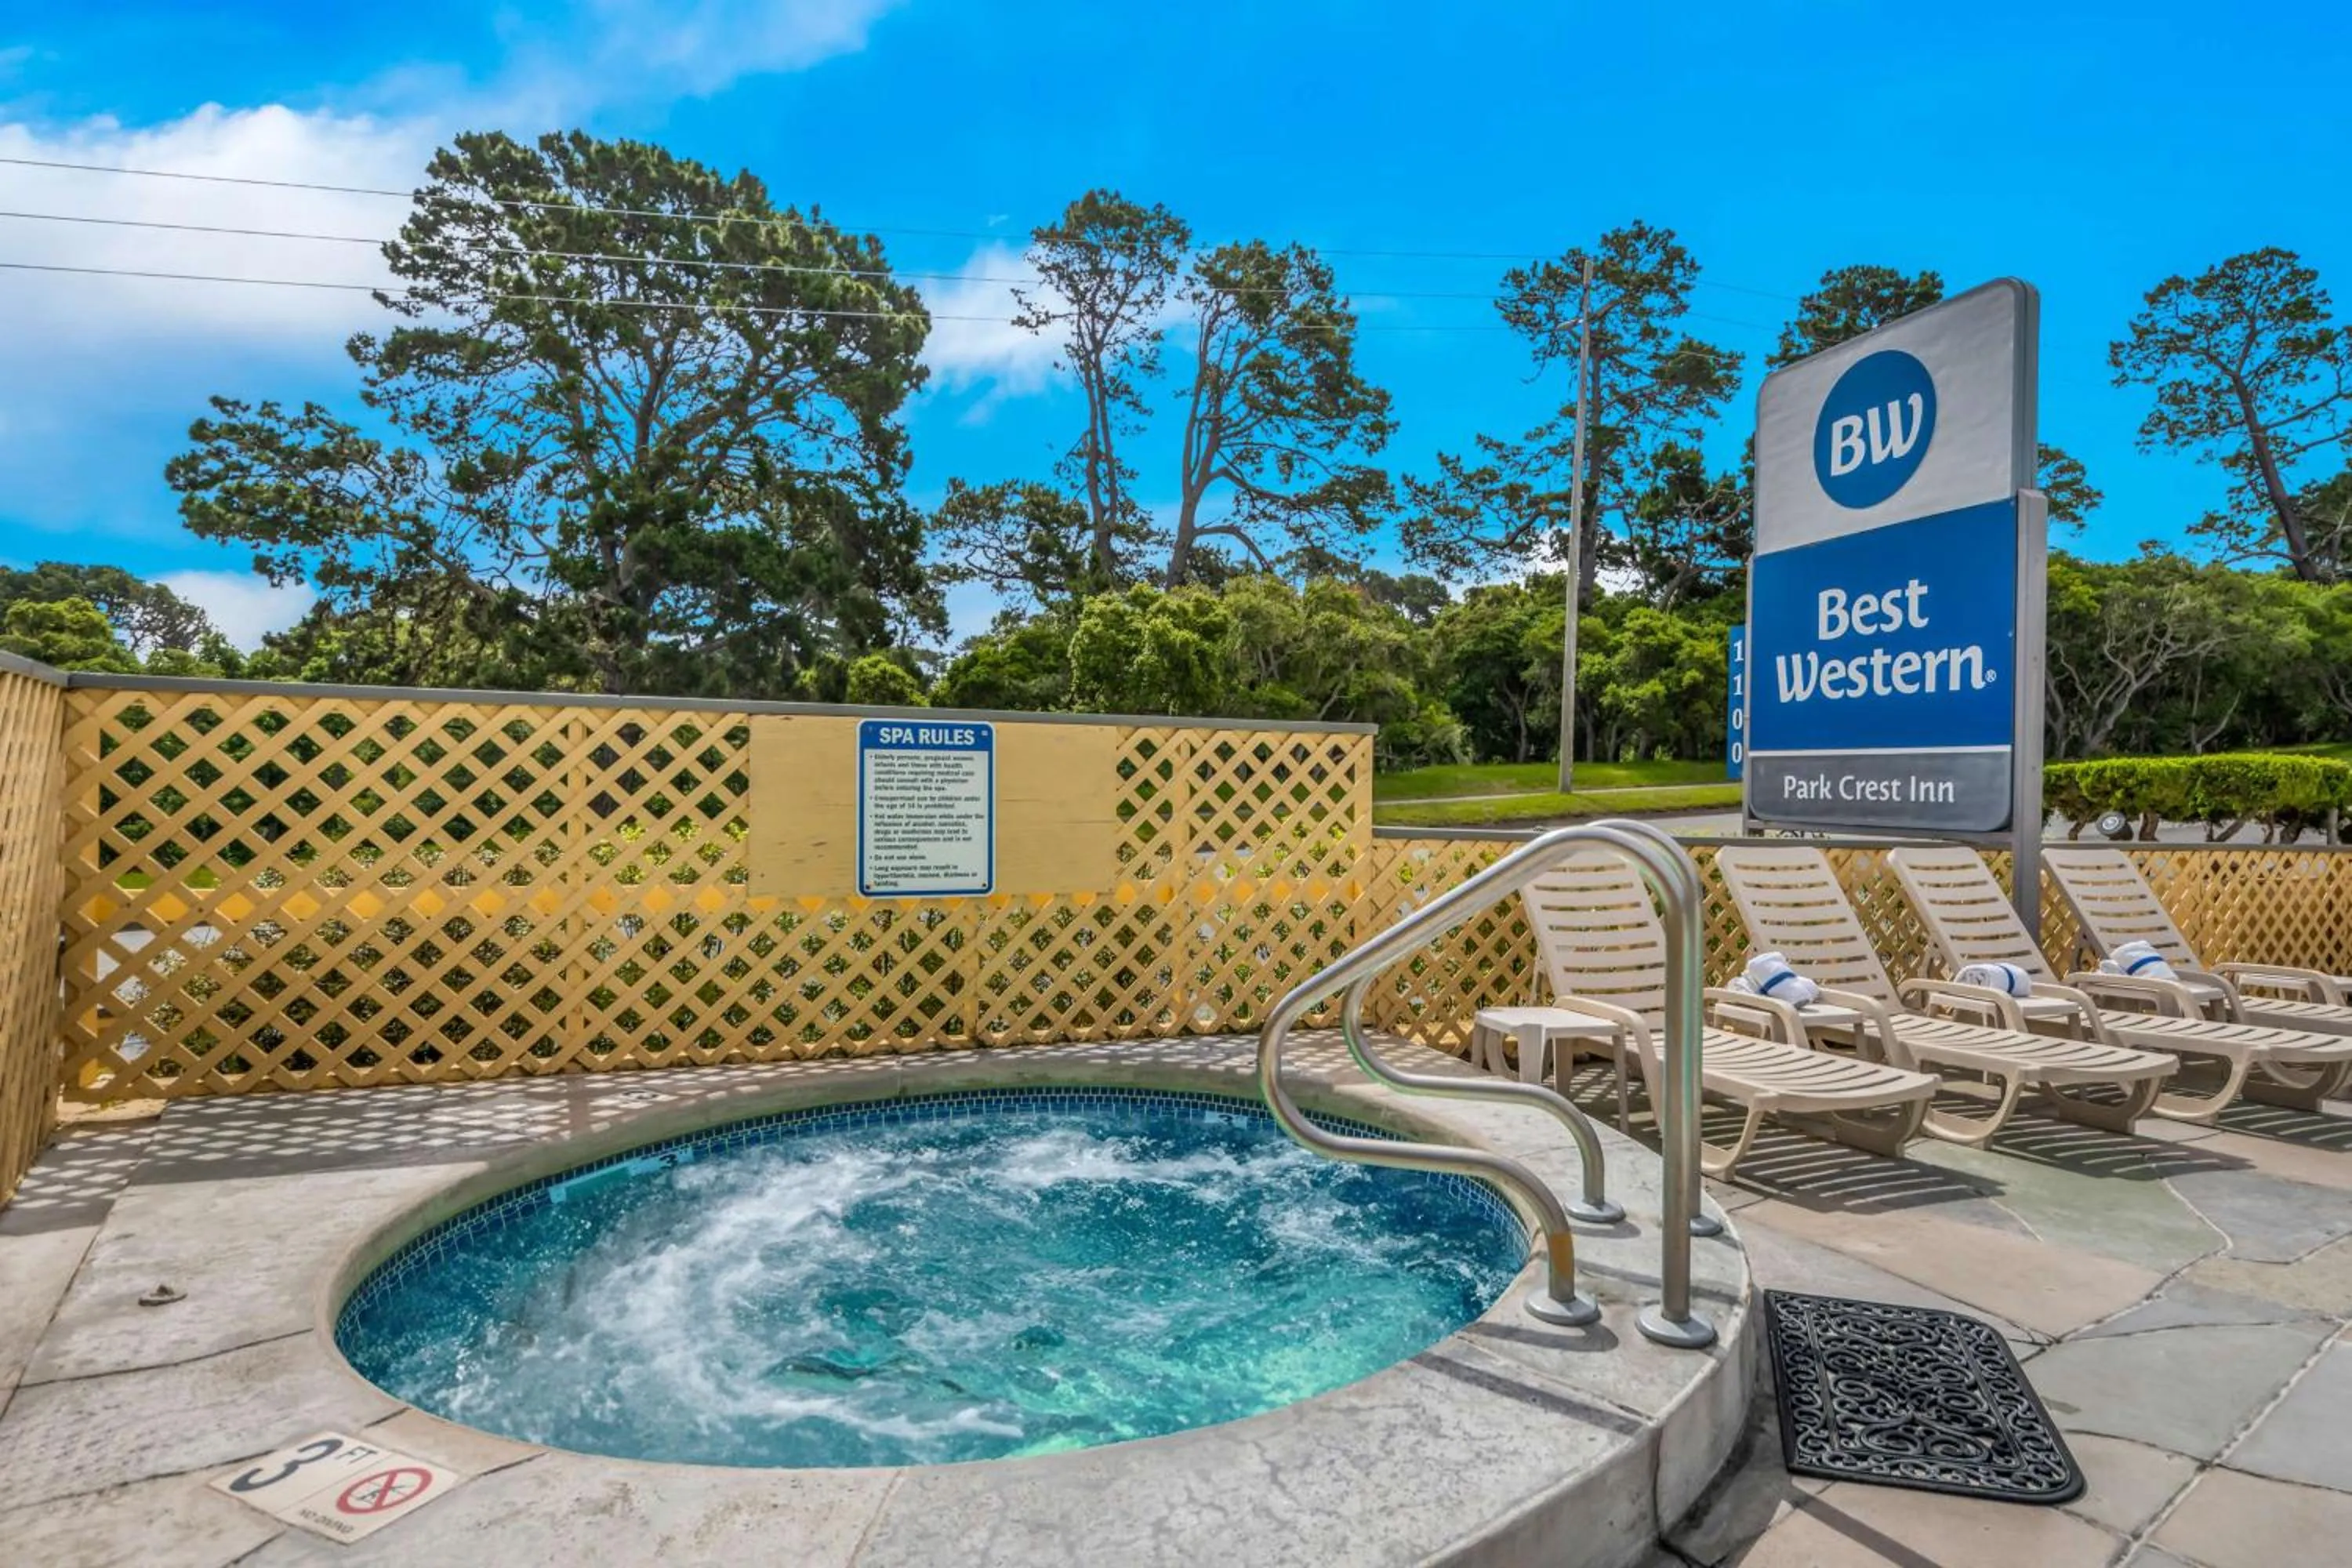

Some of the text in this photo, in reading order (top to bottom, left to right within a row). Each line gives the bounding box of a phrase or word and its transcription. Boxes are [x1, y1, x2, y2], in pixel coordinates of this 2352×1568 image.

[1831, 392, 1922, 477] BW
[1818, 579, 1929, 641] Best
[879, 728, 975, 746] SPA RULES
[1784, 774, 1955, 803] Park Crest Inn
[228, 1439, 378, 1493] 3 FT
